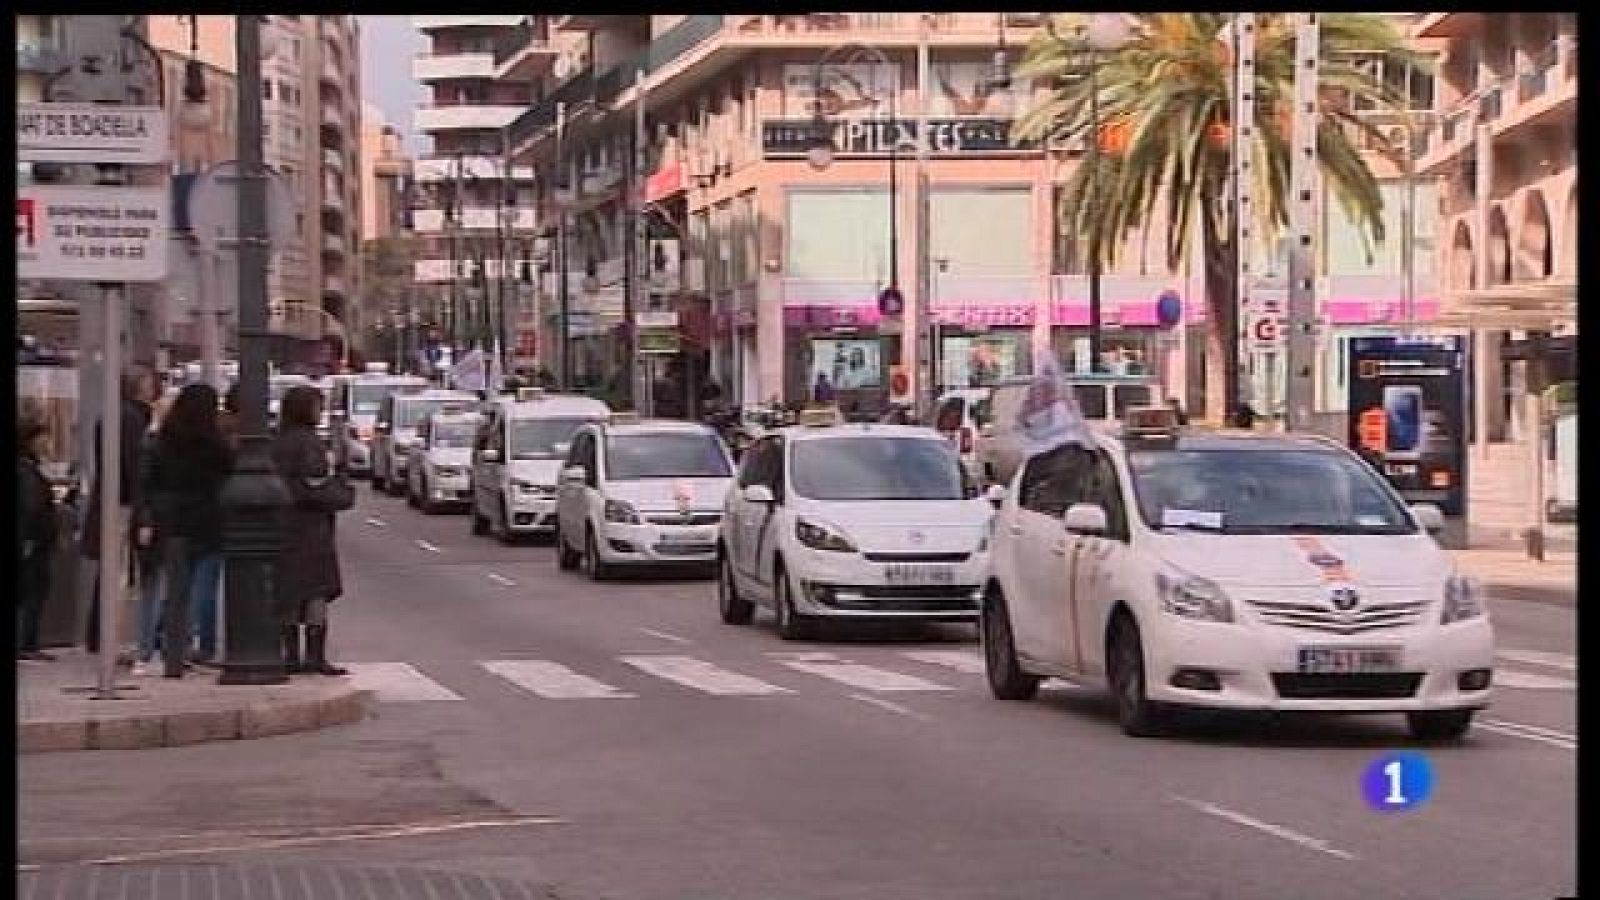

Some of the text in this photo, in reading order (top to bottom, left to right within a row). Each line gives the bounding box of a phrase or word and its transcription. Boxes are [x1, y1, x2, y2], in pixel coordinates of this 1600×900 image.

[46, 114, 66, 136] DE
[69, 115, 149, 138] BOADELLA
[124, 209, 158, 220] PARA
